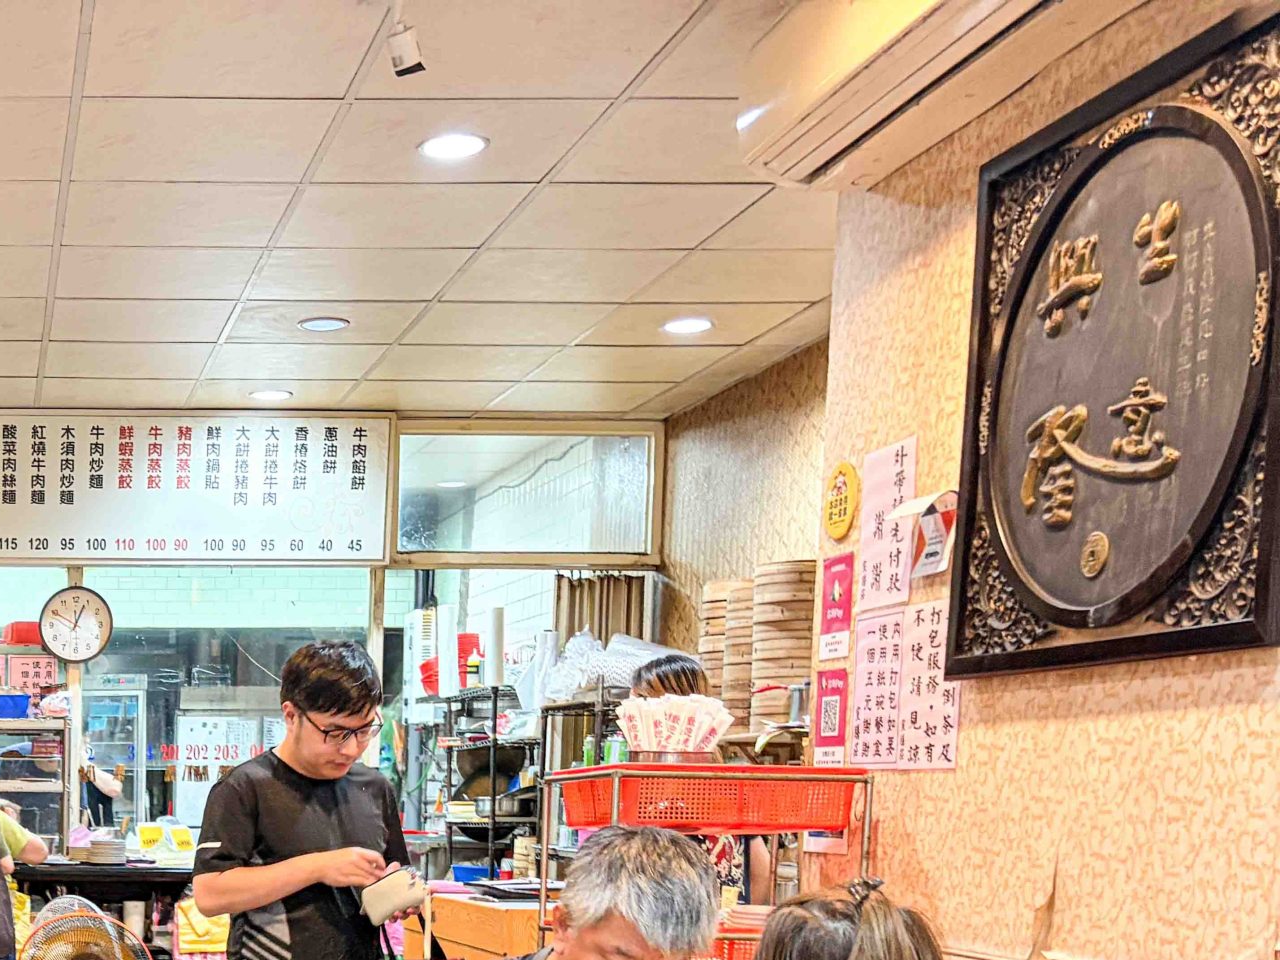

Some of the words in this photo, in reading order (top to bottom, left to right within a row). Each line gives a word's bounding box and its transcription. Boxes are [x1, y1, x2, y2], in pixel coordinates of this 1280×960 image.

[2, 425, 17, 504] 酸菜肉絲麵
[30, 425, 46, 505] 紅燒牛肉麵
[60, 425, 75, 505] 木須肉炒麵
[89, 425, 104, 489] 牛肉炒麵
[118, 426, 133, 489] 鮮蝦蒸餃
[147, 426, 163, 489] 牛肉蒸餃
[176, 426, 192, 489] 豬肉蒸餃
[205, 426, 221, 490] 鮮肉鍋貼
[351, 427, 368, 490] 牛肉餡餅
[234, 426, 250, 506] 大餅捲豬肉
[262, 426, 280, 506] 大餅捲牛肉
[28, 538, 48, 550] 120
[61, 538, 74, 550] 95
[86, 538, 106, 551] 100
[115, 538, 134, 551] 110
[146, 539, 166, 551] 100
[174, 539, 188, 551] 90
[203, 539, 223, 551] 100
[232, 539, 245, 551] 90
[260, 539, 275, 551] 95
[290, 539, 303, 551] 60
[319, 539, 332, 551] 40
[348, 539, 362, 551] 45
[186, 744, 208, 760] 202
[214, 744, 239, 760] 203
